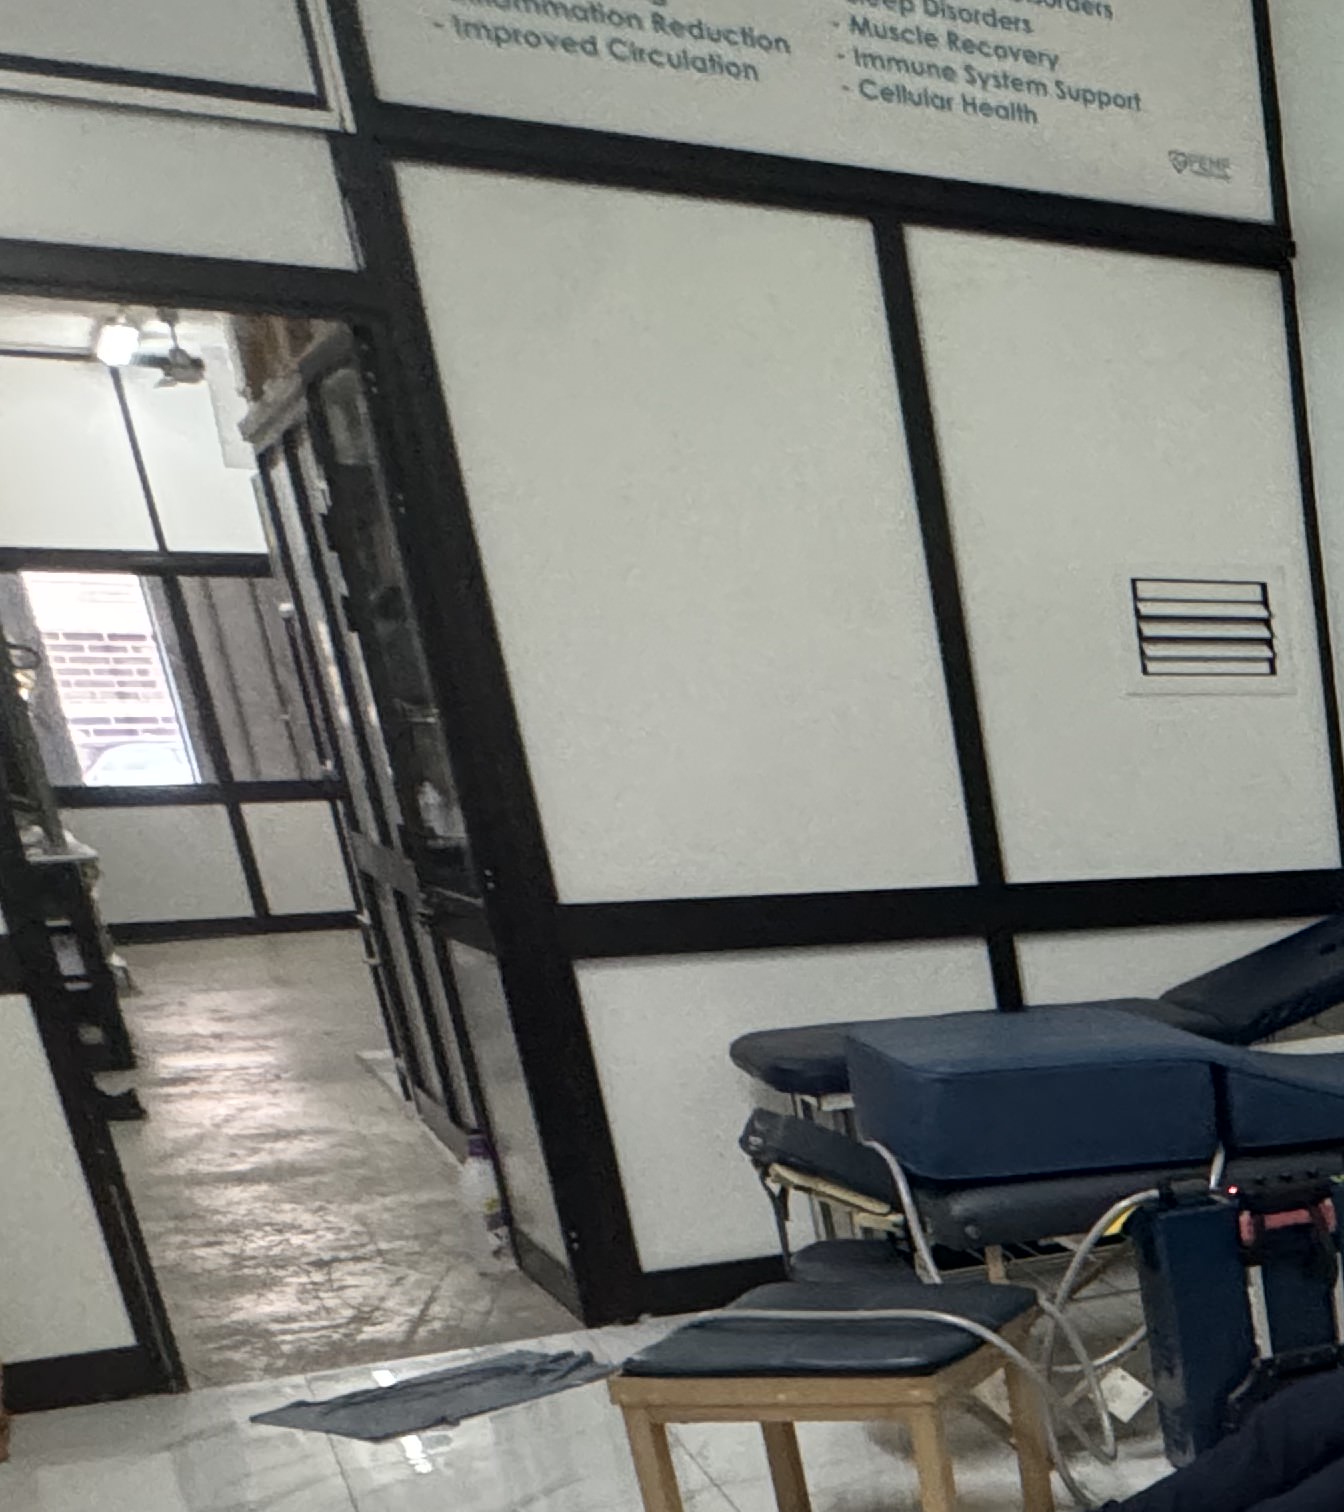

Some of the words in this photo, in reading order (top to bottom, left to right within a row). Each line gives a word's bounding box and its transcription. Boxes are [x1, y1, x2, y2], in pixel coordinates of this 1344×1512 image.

[451, 0, 643, 30] ammation
[652, 12, 791, 54] Reduction
[848, 15, 939, 49] Muscle
[947, 30, 1059, 71] Recovery
[922, 0, 1034, 34] Disorders
[452, 15, 599, 57] Improved
[609, 37, 760, 82] Circulation
[853, 48, 957, 82] Immune
[965, 65, 1049, 99] System
[1055, 79, 1142, 111] Support
[858, 79, 954, 112] Cellular
[962, 93, 1039, 125] Health
